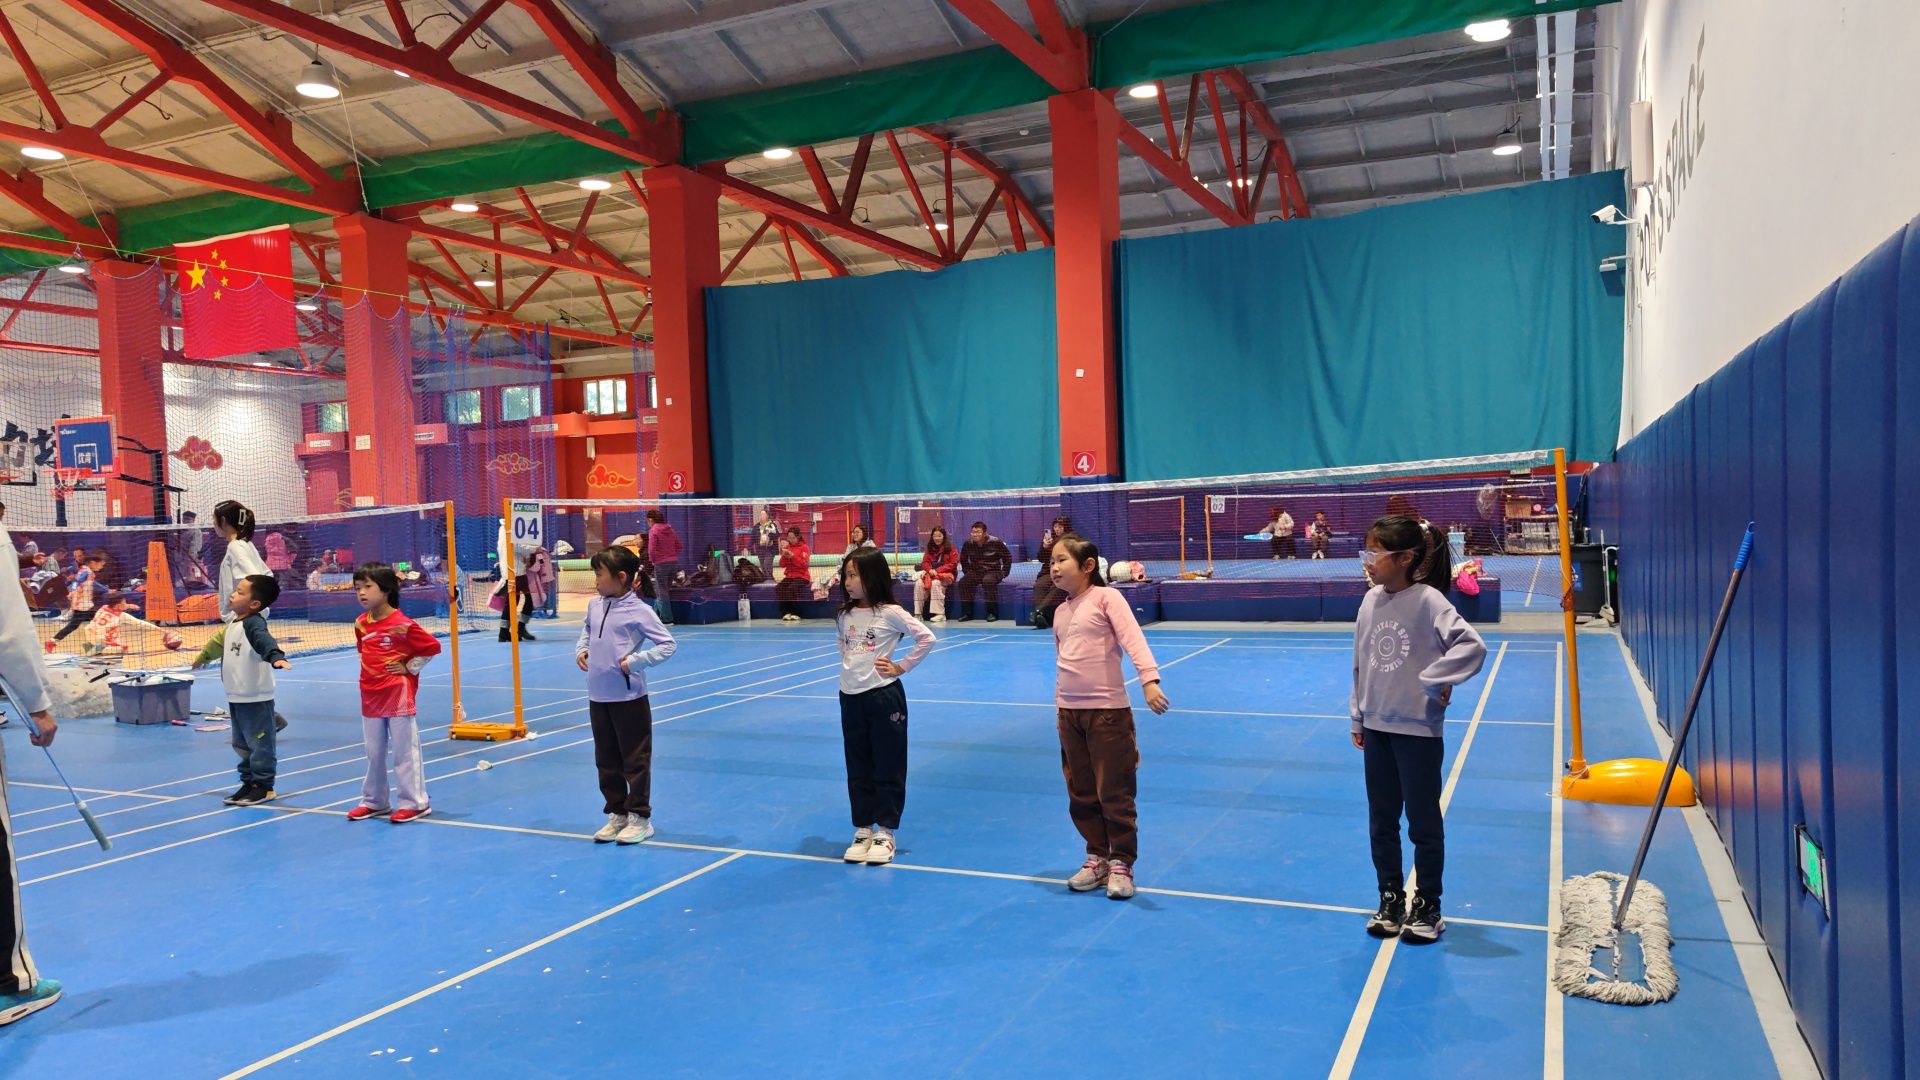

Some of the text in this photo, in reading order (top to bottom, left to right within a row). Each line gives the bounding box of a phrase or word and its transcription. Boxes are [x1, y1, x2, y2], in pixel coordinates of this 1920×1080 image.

[1665, 23, 1706, 234] SPACE
[1077, 455, 1090, 472] 4
[672, 474, 682, 490] 3
[1212, 502, 1224, 511] 02
[514, 516, 540, 540] 04
[1397, 627, 1410, 658] SPORT
